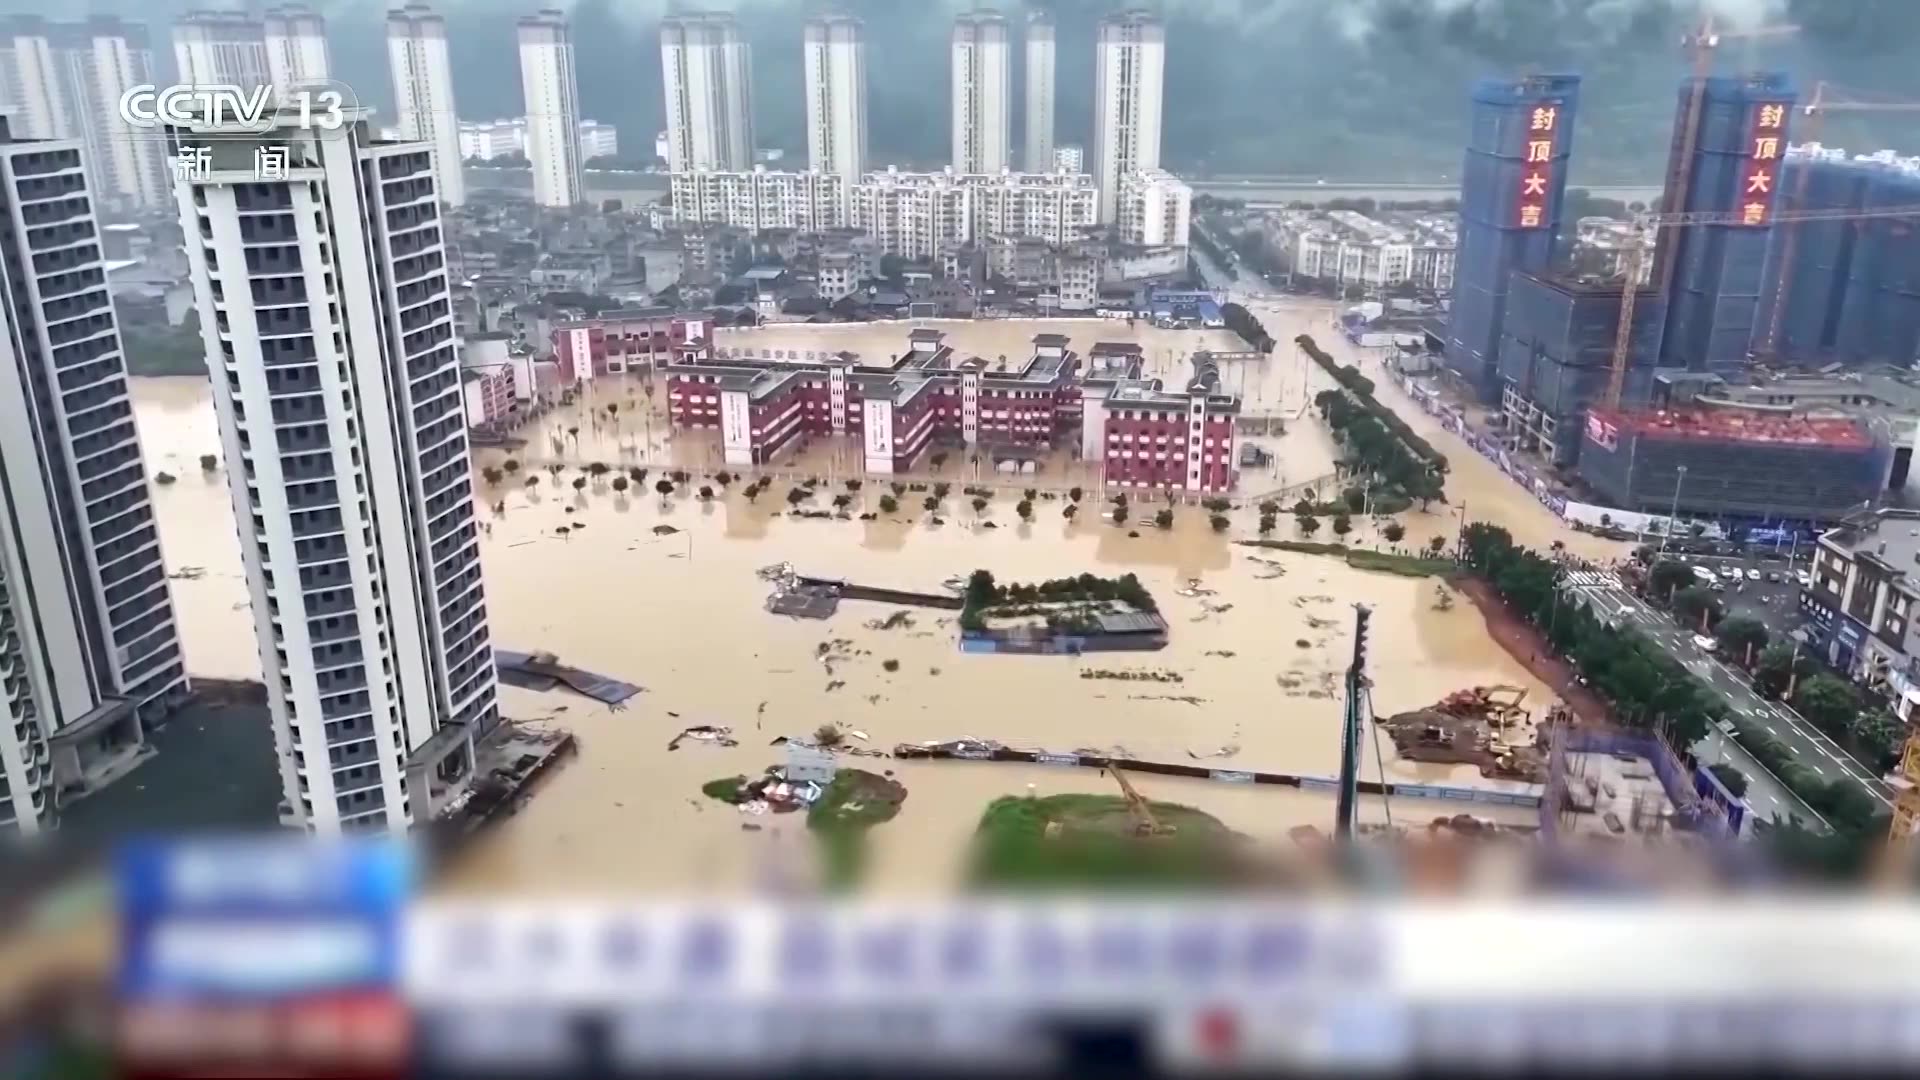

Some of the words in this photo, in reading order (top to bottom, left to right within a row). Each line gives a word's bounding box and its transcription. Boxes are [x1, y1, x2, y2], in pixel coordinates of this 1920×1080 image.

[1520, 107, 1556, 227] 封顶大吉
[1743, 104, 1783, 225] 封顶大吉
